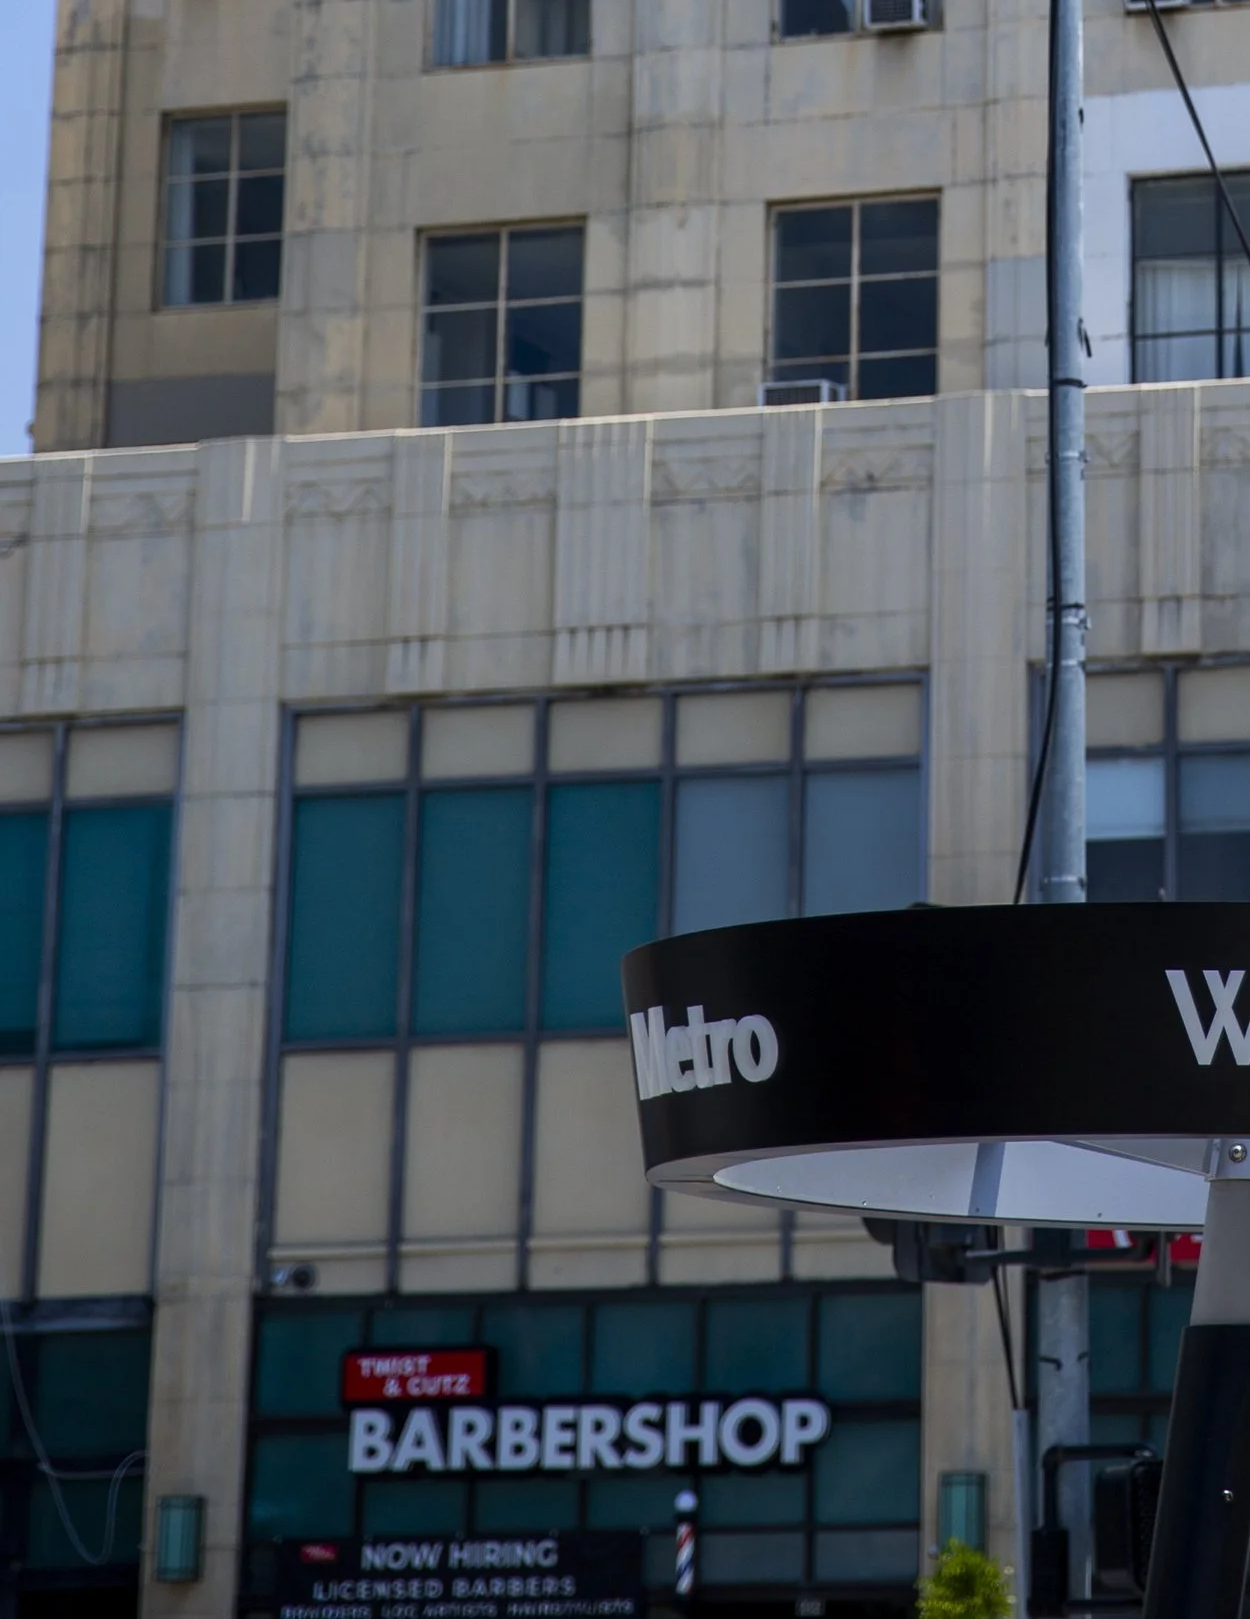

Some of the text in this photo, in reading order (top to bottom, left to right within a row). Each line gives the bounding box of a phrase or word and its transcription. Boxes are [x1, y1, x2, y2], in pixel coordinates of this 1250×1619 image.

[630, 1005, 779, 1101] Metro
[357, 1355, 431, 1378] TWIST
[406, 1374, 471, 1397] CUTZ
[349, 1399, 828, 1472] BARBERSHOP
[361, 1543, 443, 1571] NOW
[448, 1539, 559, 1569] HIRING
[313, 1576, 577, 1601] LICENSED BARBERS
